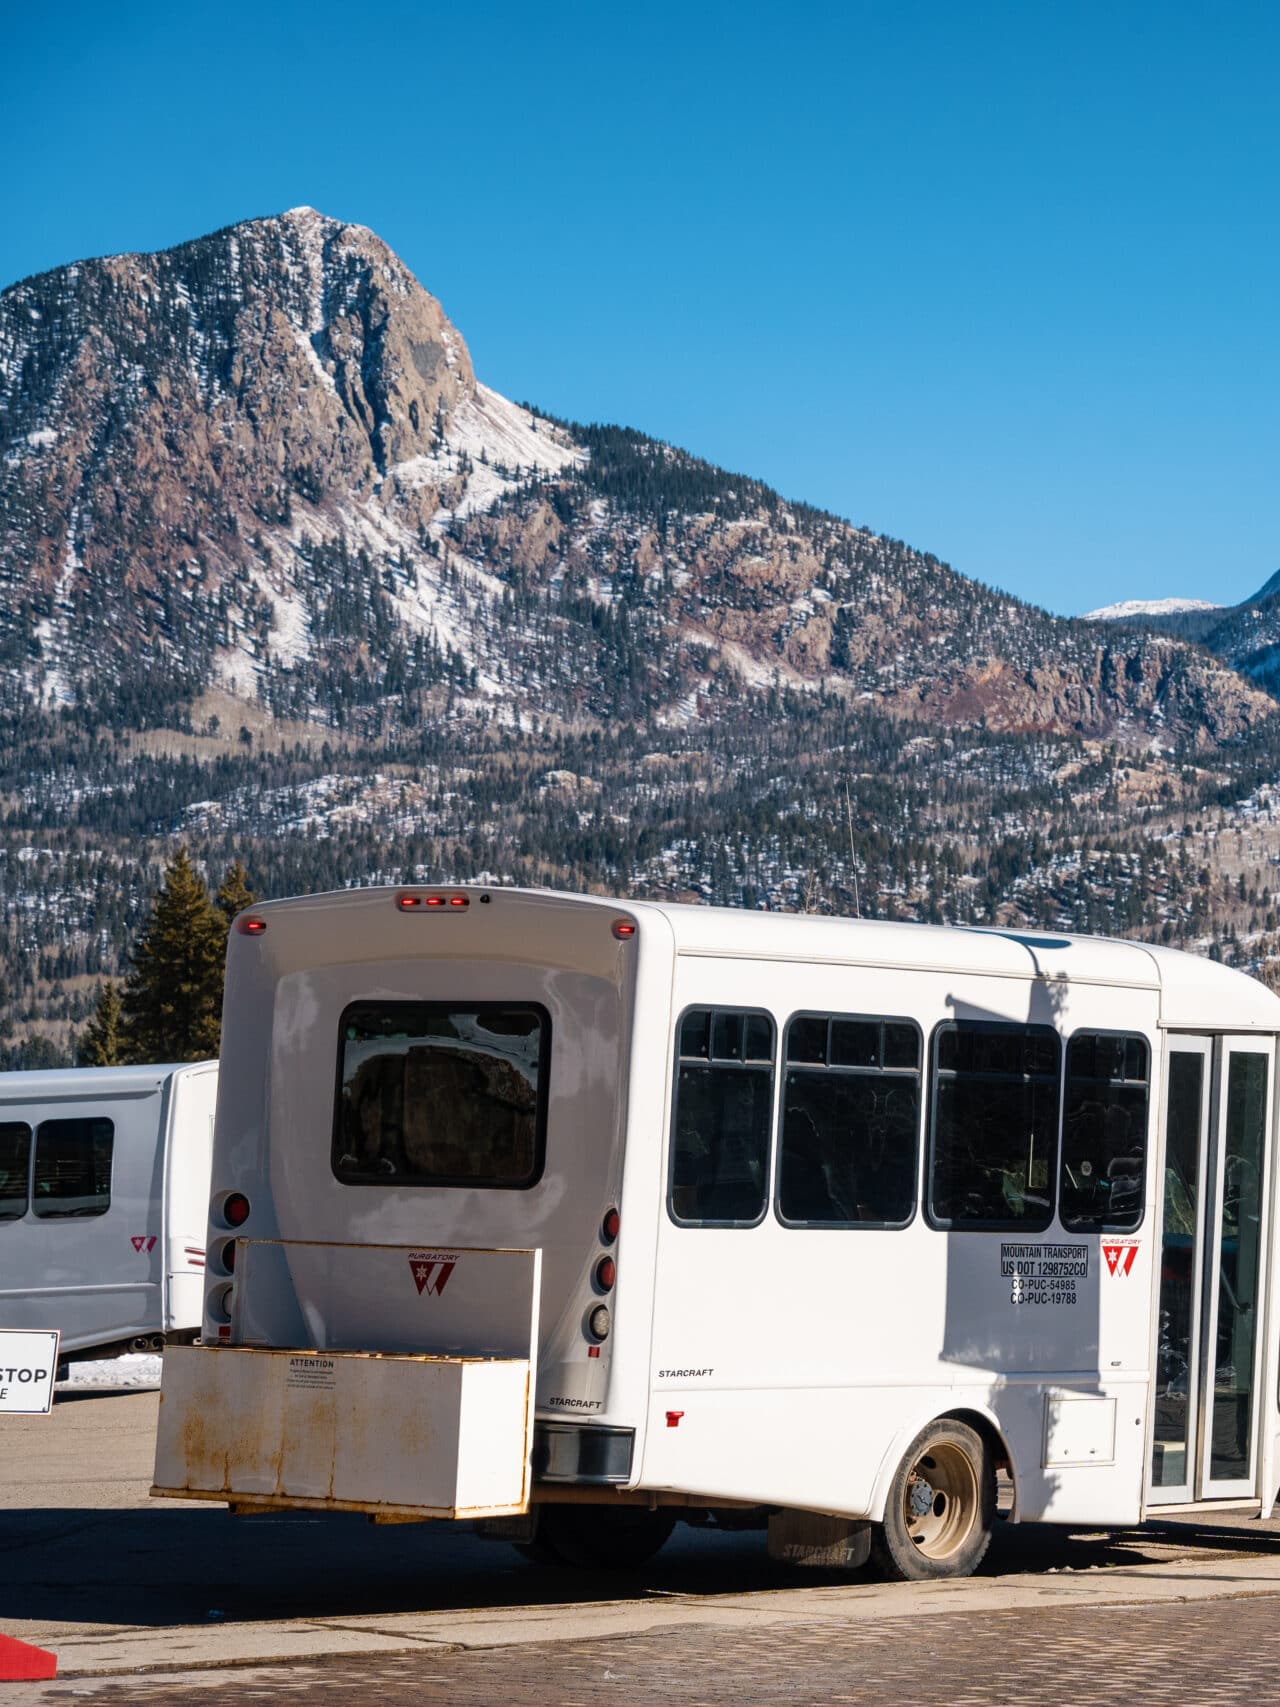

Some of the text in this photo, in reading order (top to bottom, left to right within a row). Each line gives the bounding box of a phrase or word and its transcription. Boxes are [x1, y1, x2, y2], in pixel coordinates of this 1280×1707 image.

[408, 1252, 460, 1260] PURGATORY
[1003, 1246, 1086, 1259] MOUNTAIN TRANSPORT
[1003, 1261, 1086, 1276] US DOT 1298752CO
[1011, 1279, 1076, 1290] CO-PUC-54985
[1010, 1292, 1077, 1304] CO-PUC-19788
[290, 1359, 334, 1368] ATTENTION
[0, 1368, 48, 1383] TOP
[658, 1369, 714, 1378] STARCRAFT
[549, 1397, 602, 1409] STARCRAFT
